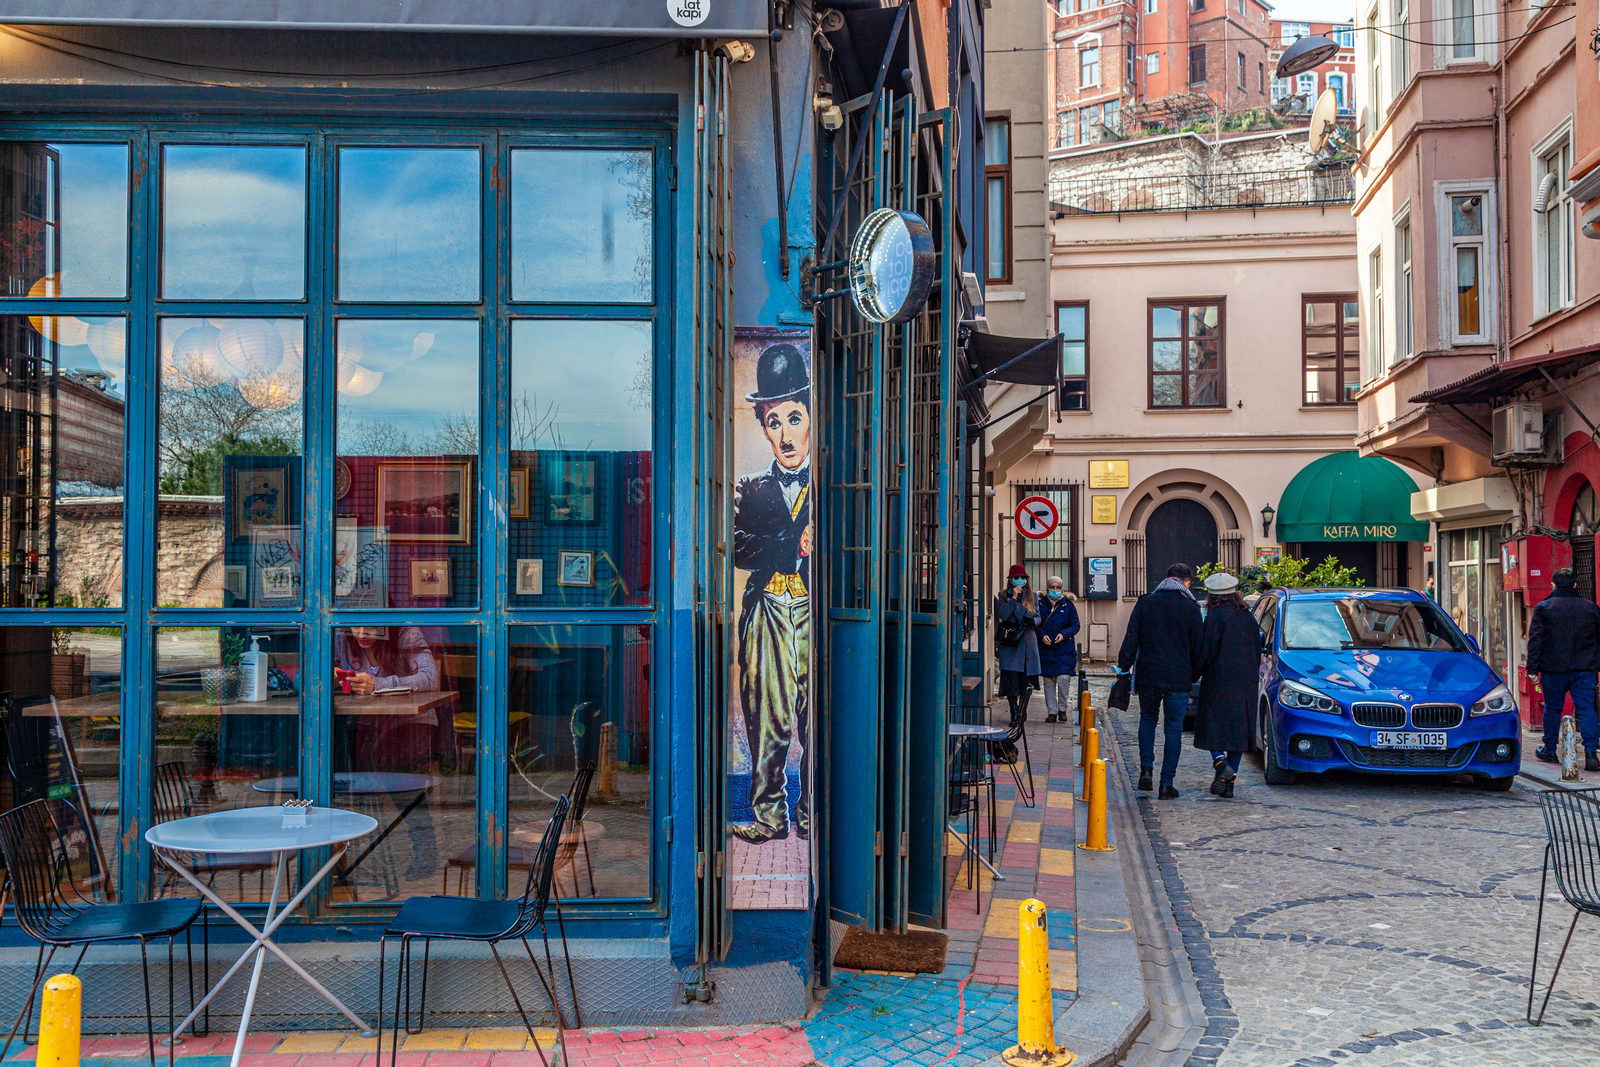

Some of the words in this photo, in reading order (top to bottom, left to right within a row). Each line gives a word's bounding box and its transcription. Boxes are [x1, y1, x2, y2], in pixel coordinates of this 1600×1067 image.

[684, 0, 700, 9] lat
[1323, 526, 1359, 539] KAFFA
[1378, 733, 1391, 744] 34
[1396, 733, 1410, 745] SF
[1417, 734, 1445, 745] 1035
